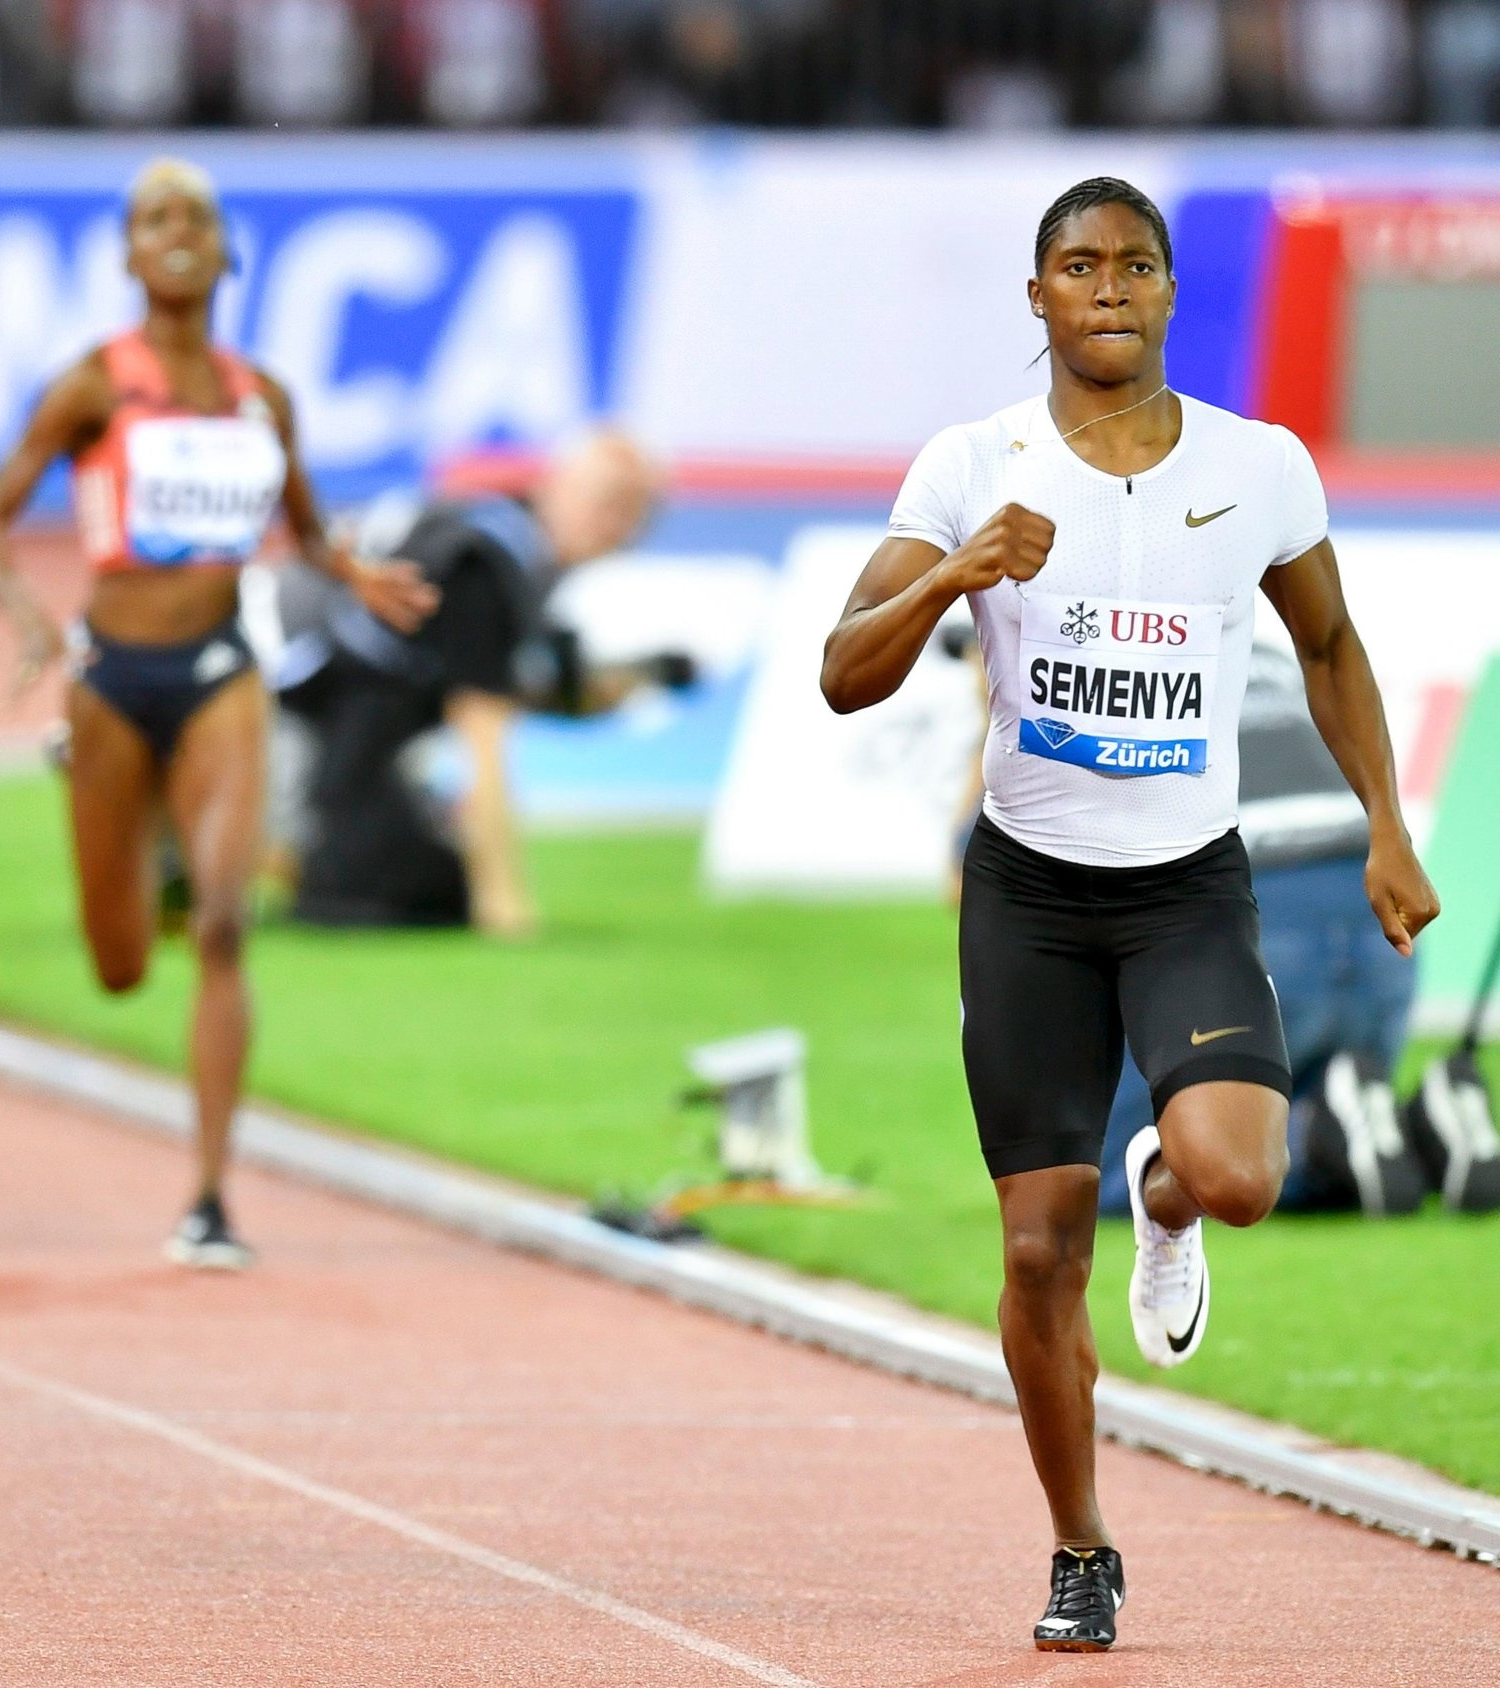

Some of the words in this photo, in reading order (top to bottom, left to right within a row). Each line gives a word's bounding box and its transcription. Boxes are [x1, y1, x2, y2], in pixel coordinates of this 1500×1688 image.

[1109, 609, 1188, 646] UBS
[1030, 657, 1201, 720] SEMENYA
[1096, 740, 1190, 768] Zürich
